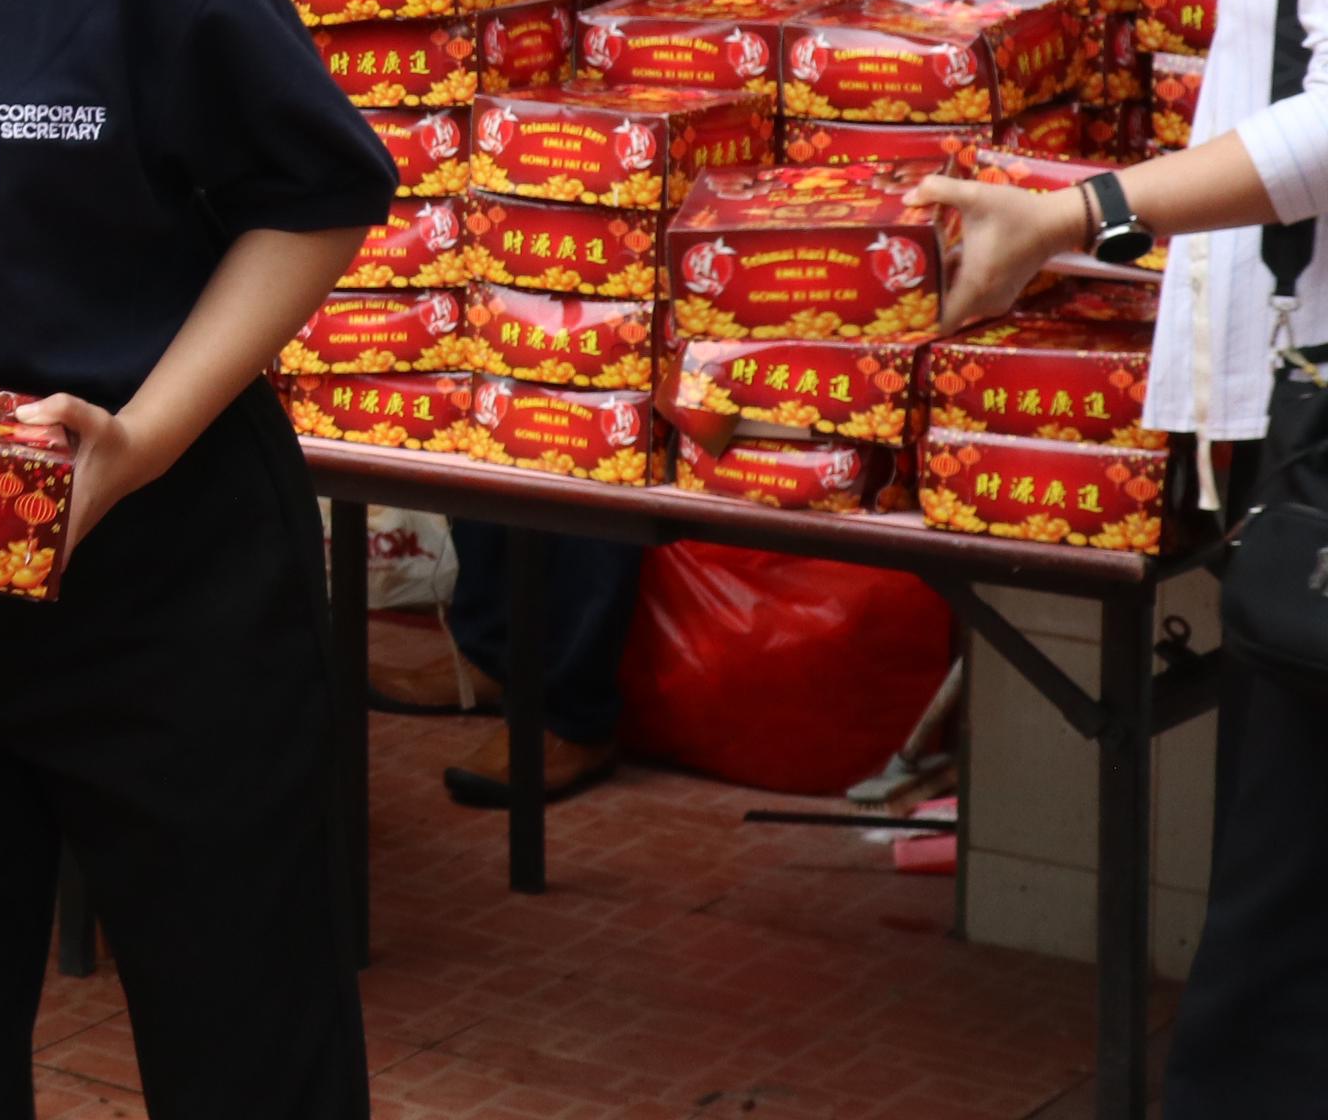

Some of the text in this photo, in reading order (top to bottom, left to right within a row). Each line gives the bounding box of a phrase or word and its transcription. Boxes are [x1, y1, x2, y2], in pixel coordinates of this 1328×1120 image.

[0, 122, 102, 140] SECRETARY
[520, 154, 601, 173] GONG XI FAT CAI
